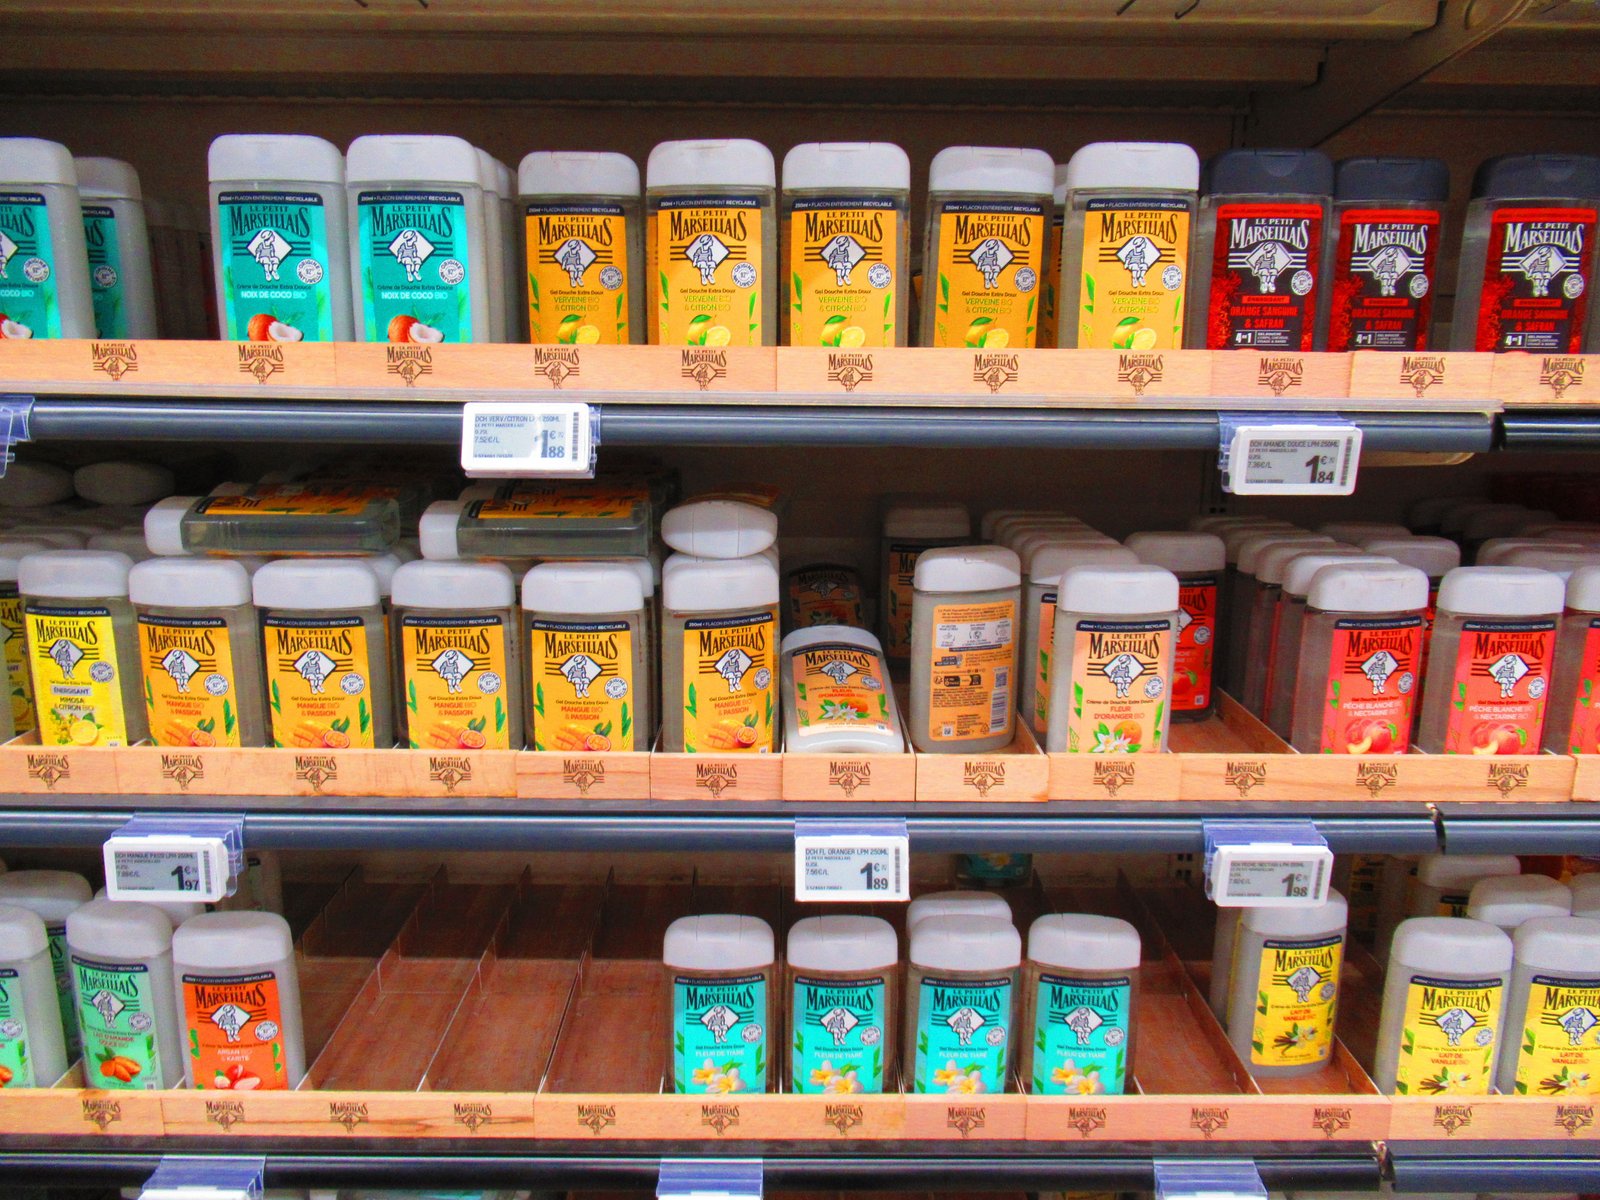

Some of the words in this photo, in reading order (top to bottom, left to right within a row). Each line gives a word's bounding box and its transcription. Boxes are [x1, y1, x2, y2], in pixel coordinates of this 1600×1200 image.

[231, 206, 310, 237] MARSEILLAIS
[371, 206, 452, 238] MARSEILLAIS
[539, 217, 612, 246] MARSEILLAIS
[670, 210, 747, 241] MARSEILLAIS
[805, 212, 883, 242] MARSEILLAIS
[953, 215, 1031, 247] MARSEILLAIS
[1100, 212, 1178, 244] MARSEILLAIS
[1230, 219, 1309, 250] MARSEILLAIS
[1353, 224, 1428, 255] MARSEILLAIS
[1503, 223, 1584, 254] MARSEILLAIS
[692, 304, 717, 312] CITRON
[1231, 307, 1261, 316] ORANGE
[91, 344, 137, 360] MARSEILLAIS
[239, 345, 284, 362] MARSEILLAIS
[387, 346, 432, 362] MARSEILLAIS
[534, 347, 579, 365] MARSEILLAIS
[682, 350, 726, 367] MARSEILLAIS
[828, 353, 873, 371] MARSEILLAIS
[974, 354, 1018, 371] MARSEILLAIS
[1118, 354, 1163, 371] MARSEILLAIS
[549, 446, 565, 458] 88
[1320, 456, 1328, 465] €
[1305, 455, 1320, 483] 1
[1317, 471, 1334, 483] 84
[36, 619, 97, 644] MARSEILLAIS
[147, 627, 215, 656] MARSEILLAIS
[277, 629, 352, 655] MARSEILLAIS
[415, 628, 490, 655] MARSEILLAIS
[699, 625, 765, 657] MARSEILLAIS
[1346, 629, 1413, 657] MARSEILLAIS
[545, 633, 618, 660] MARSEILLAIS
[1088, 633, 1160, 659] MARSEILLAIS
[1474, 633, 1545, 660] MARSEILLAIS
[805, 653, 870, 667] MARSEILLAIS
[1094, 712, 1133, 720] D'ORANGER
[171, 866, 184, 890] 1
[185, 880, 199, 890] 97
[861, 863, 872, 890] 1
[874, 863, 880, 871] €
[874, 878, 888, 890] 89
[1282, 873, 1295, 897] 1
[1293, 887, 1307, 897] 98
[1275, 947, 1334, 971] MARSEILLAIS
[80, 968, 138, 997] MARSEILLAIS
[195, 983, 266, 1008] MARSEILLAIS
[686, 985, 754, 1010] MARSEILLAIS
[806, 987, 873, 1011] MARSEILLAIS
[933, 988, 1000, 1011] MARSEILLAIS
[1050, 986, 1118, 1011] MARSEILLAIS
[1421, 988, 1492, 1012] MARSEILLAIS
